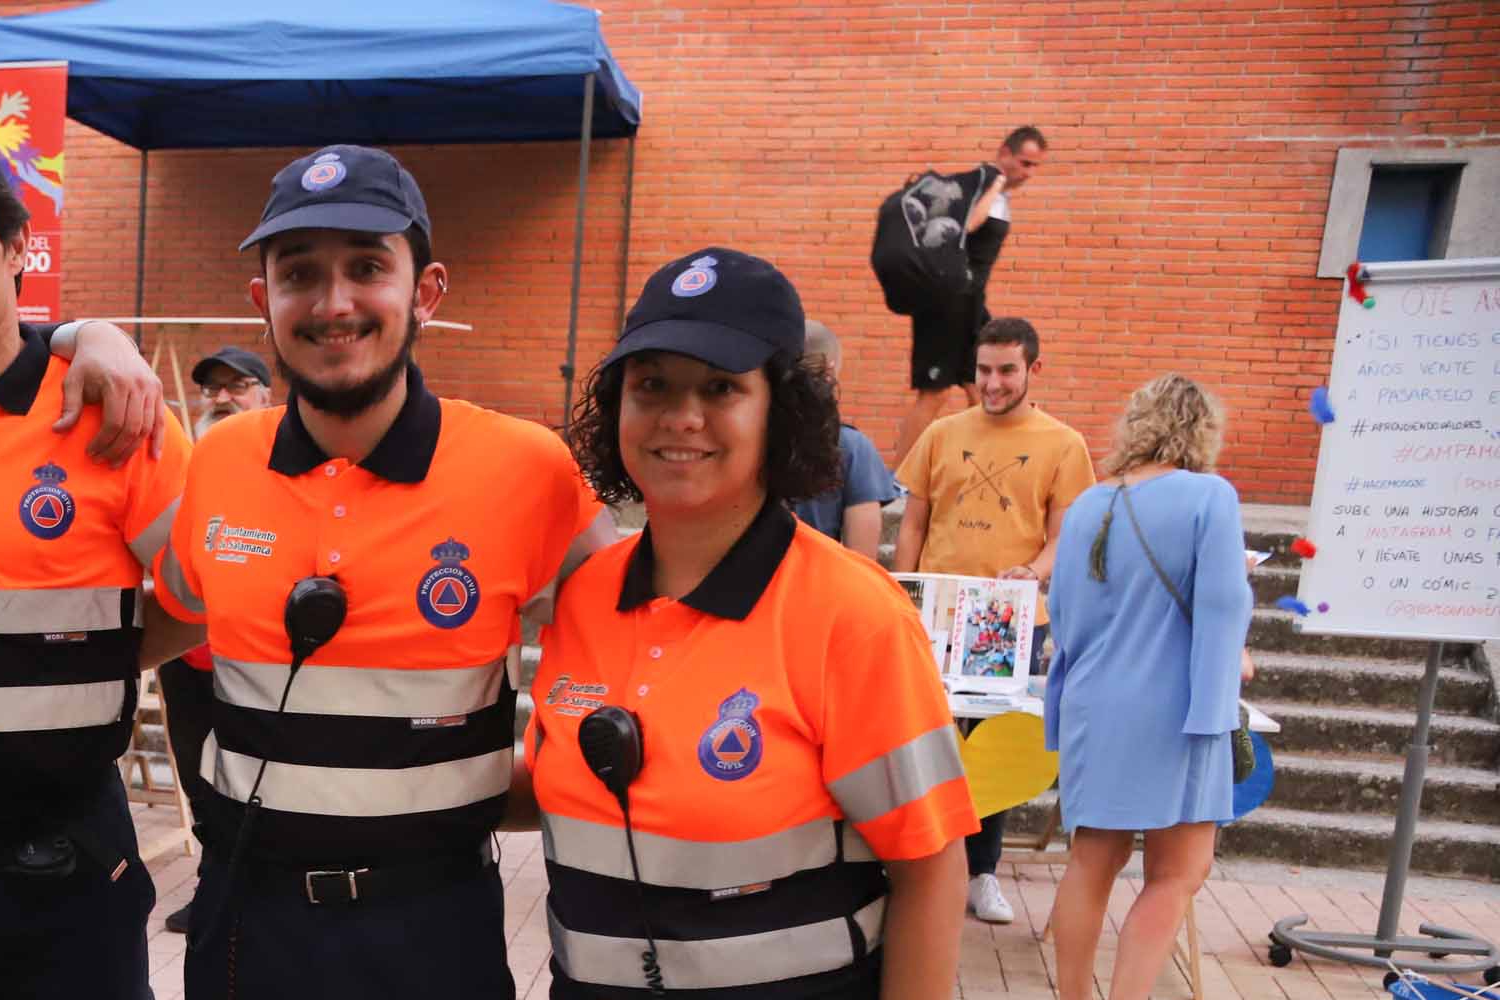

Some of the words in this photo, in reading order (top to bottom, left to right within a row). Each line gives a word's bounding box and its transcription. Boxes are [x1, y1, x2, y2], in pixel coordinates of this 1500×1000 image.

[24, 252, 52, 272] DO
[1420, 361, 1476, 376] VENTE
[1384, 505, 1409, 518] UNA
[1422, 505, 1479, 519] HISTORIA
[1336, 525, 1346, 537] A
[1366, 526, 1452, 538] INSTAGRAM
[1443, 551, 1484, 565] UNAS
[1389, 576, 1409, 589] UN
[1421, 576, 1471, 592] CÓMIC
[716, 760, 745, 771] CIVIL
